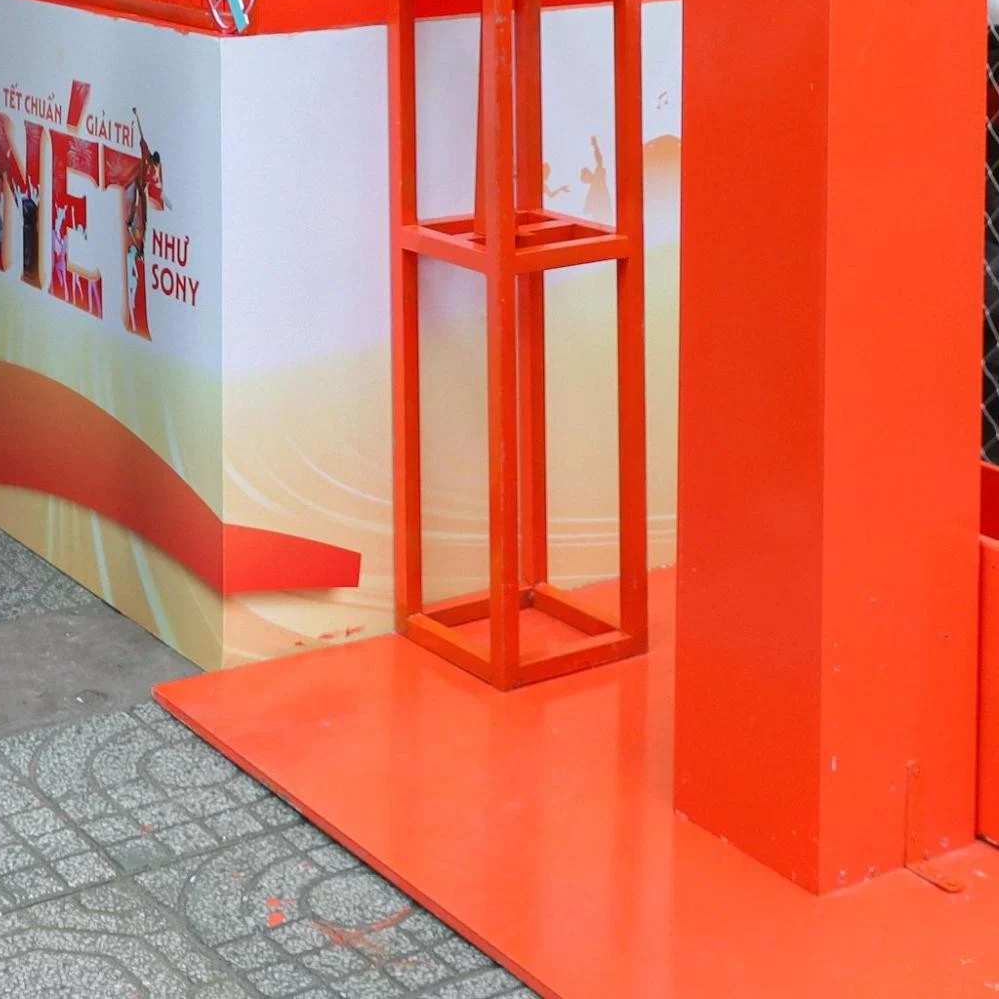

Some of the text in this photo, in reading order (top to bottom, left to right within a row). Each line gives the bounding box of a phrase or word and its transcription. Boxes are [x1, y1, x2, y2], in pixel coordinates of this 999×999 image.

[3, 83, 135, 149] TẾT CHUẨN GIẢI TRÍ
[151, 228, 190, 267] NHƯ
[151, 264, 200, 307] SONY
